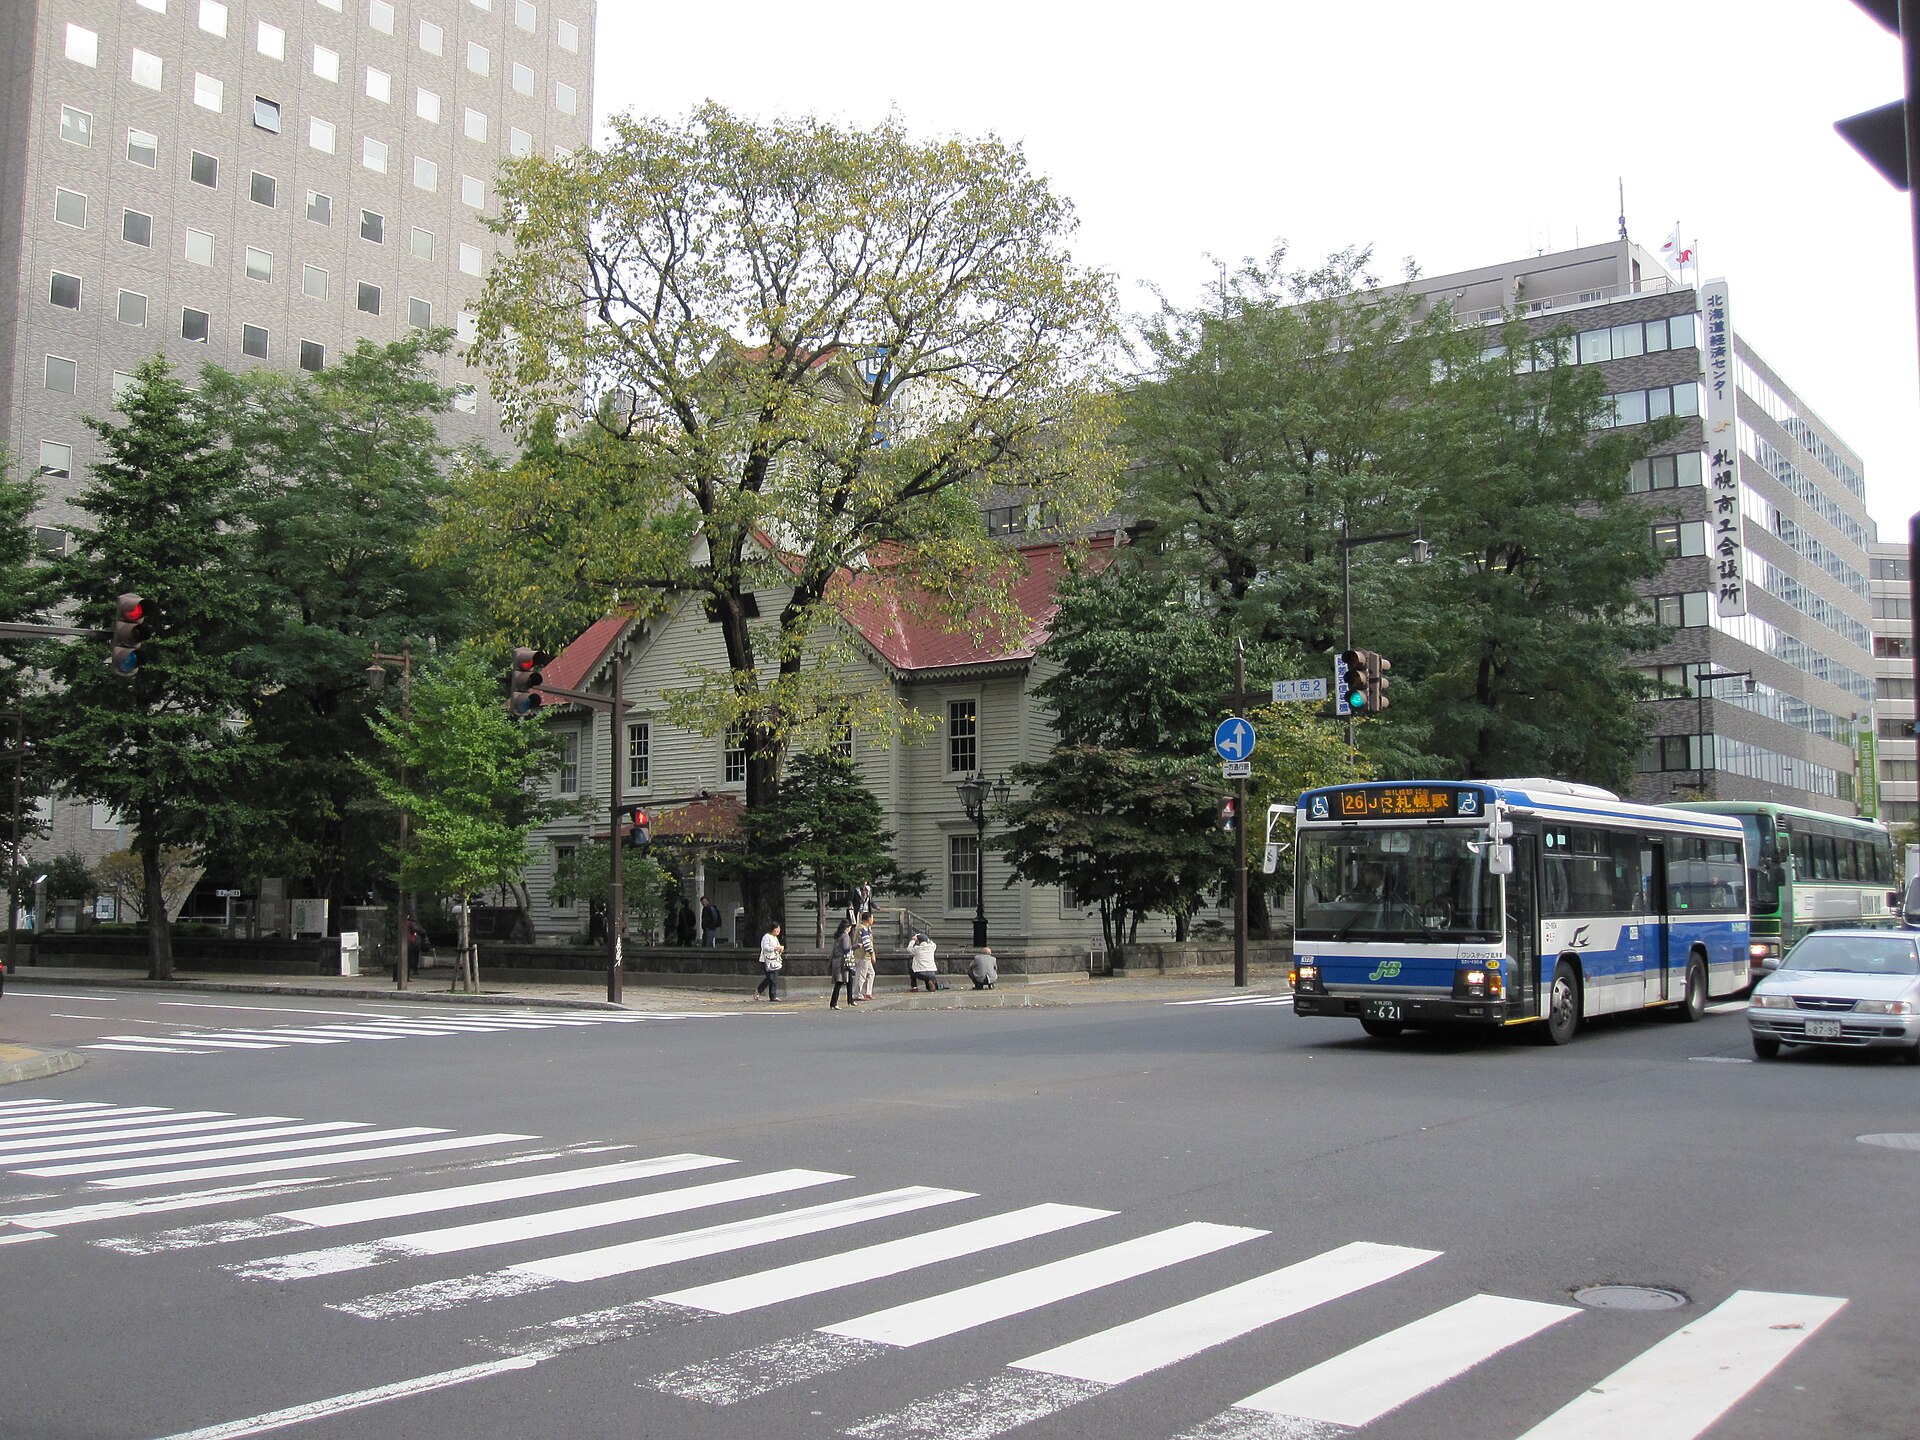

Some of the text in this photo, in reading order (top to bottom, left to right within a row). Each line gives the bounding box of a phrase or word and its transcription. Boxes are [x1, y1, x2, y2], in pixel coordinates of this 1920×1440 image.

[1706, 294, 1727, 401] 北海道経済センター
[1711, 448, 1741, 606] 札幌商工会議所
[1345, 795, 1364, 809] 26
